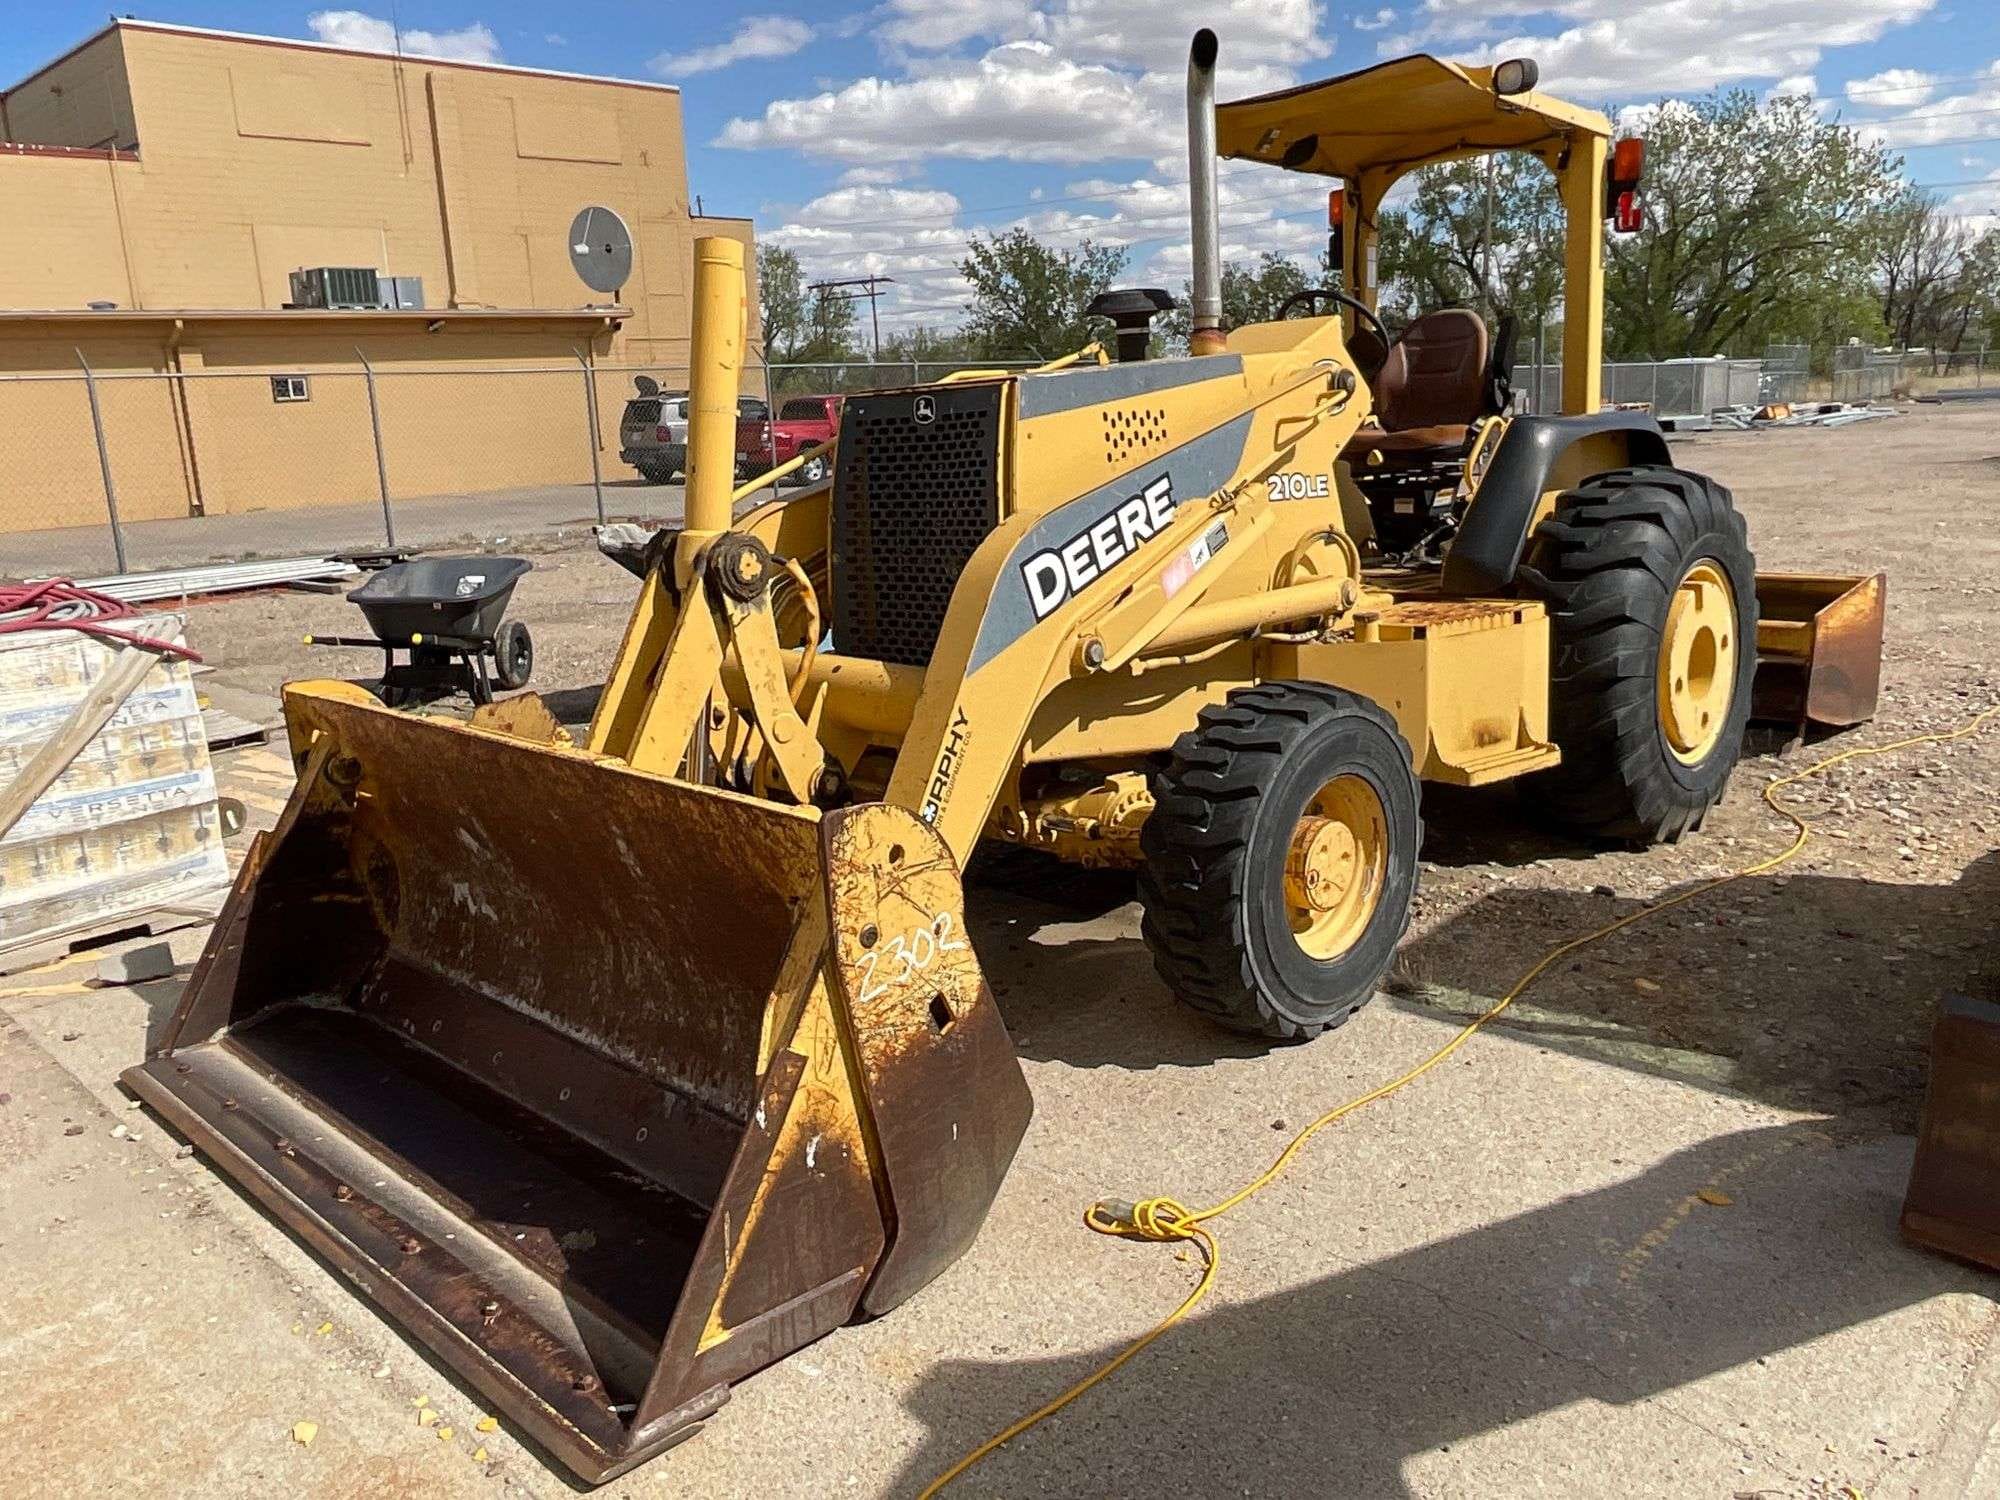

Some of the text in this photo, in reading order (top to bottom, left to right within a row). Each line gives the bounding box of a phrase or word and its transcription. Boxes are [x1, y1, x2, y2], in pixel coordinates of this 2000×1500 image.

[1266, 472, 1329, 502] 210LE
[1022, 474, 1176, 621] DEERE
[921, 704, 968, 826] URPHY
[944, 747, 966, 803] EQUIPMENT
[48, 786, 187, 819] VERSETTA
[855, 912, 966, 1002] 2302
